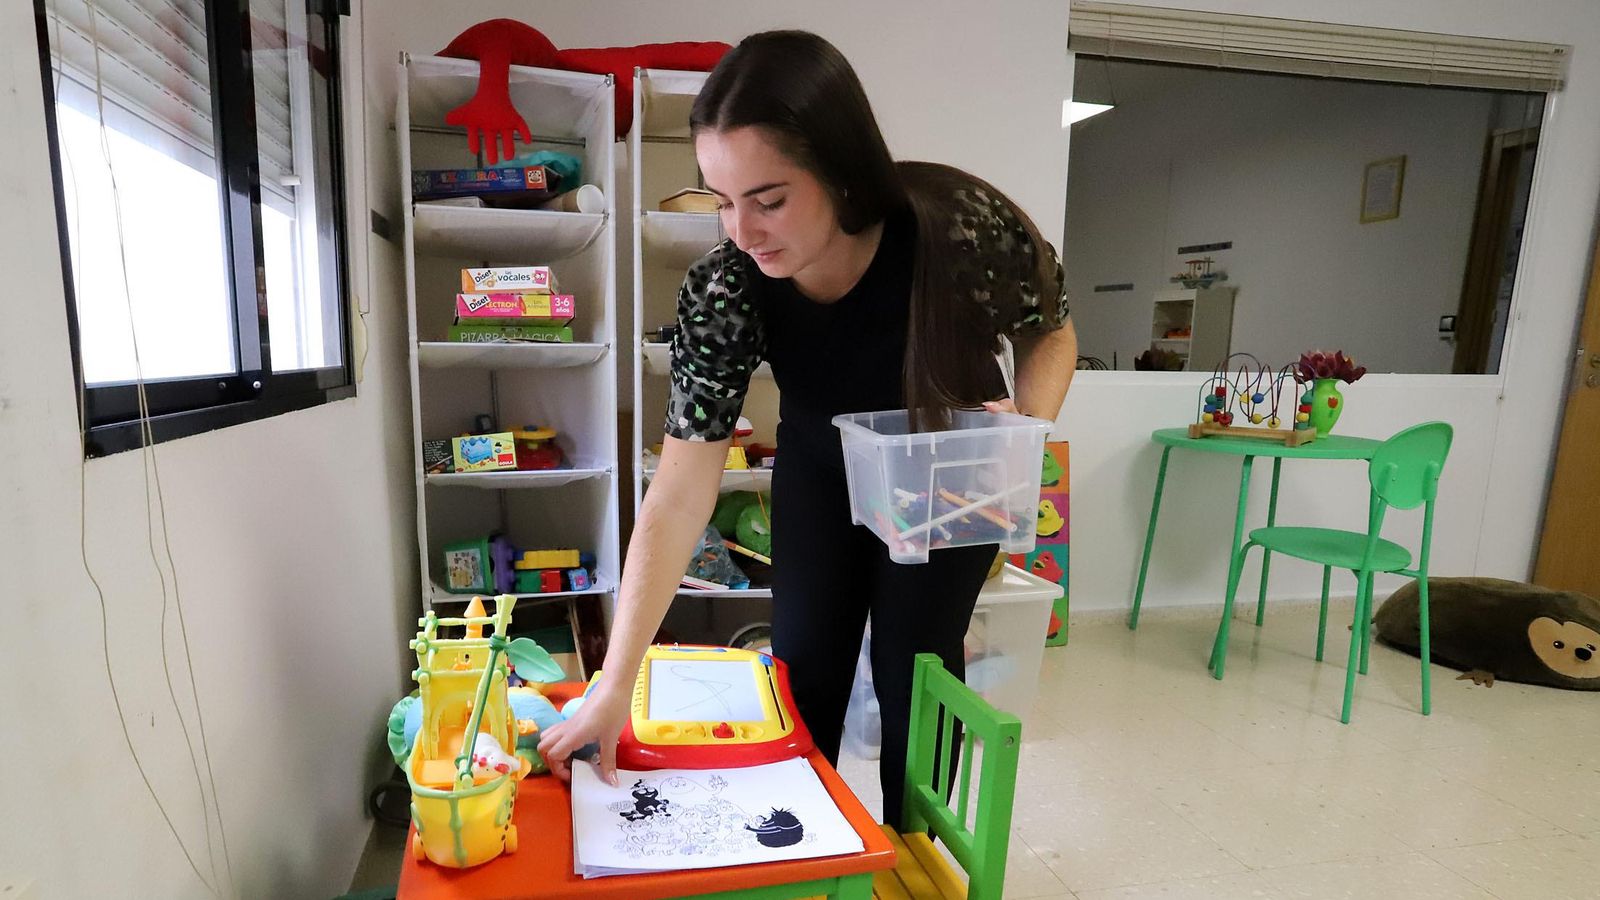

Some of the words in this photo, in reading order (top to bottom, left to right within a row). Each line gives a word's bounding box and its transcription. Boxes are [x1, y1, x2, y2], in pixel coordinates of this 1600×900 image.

[474, 269, 492, 283] Diset
[497, 273, 531, 282] vocales
[469, 295, 489, 310] Diset
[554, 297, 570, 307] 3-6
[460, 332, 507, 342] PIZARRA
